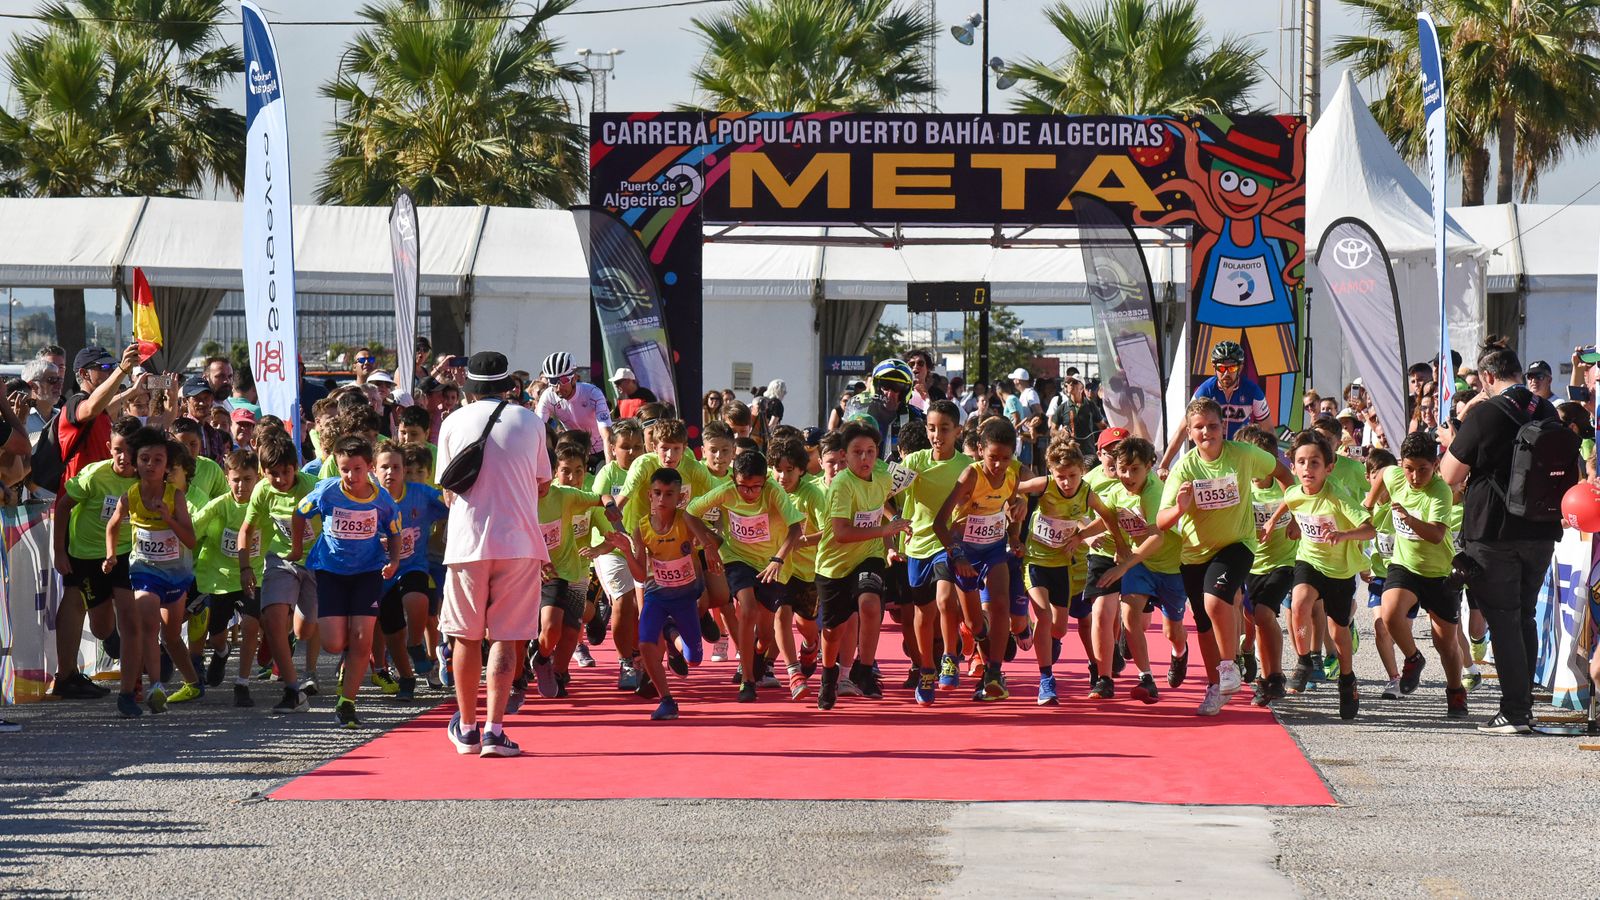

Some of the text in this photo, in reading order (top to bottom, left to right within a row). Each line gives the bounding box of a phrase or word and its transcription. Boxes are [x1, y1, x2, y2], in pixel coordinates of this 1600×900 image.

[602, 118, 1163, 146] CARRERA POPULAR PUERTO BAHÍA DE ALGECIRAS
[620, 181, 676, 191] Puerto de
[730, 152, 1166, 211] META
[603, 193, 677, 209] Algeciras
[1222, 261, 1262, 270] BOLARDITO
[1198, 488, 1226, 502] 1353
[1254, 511, 1275, 523] 135
[335, 519, 363, 531] 1263
[731, 522, 755, 536] 1205
[968, 525, 994, 536] 1485
[1300, 523, 1322, 535] 1387
[1037, 525, 1062, 540] 1194
[138, 540, 165, 553] 1522
[655, 569, 681, 580] 1553
